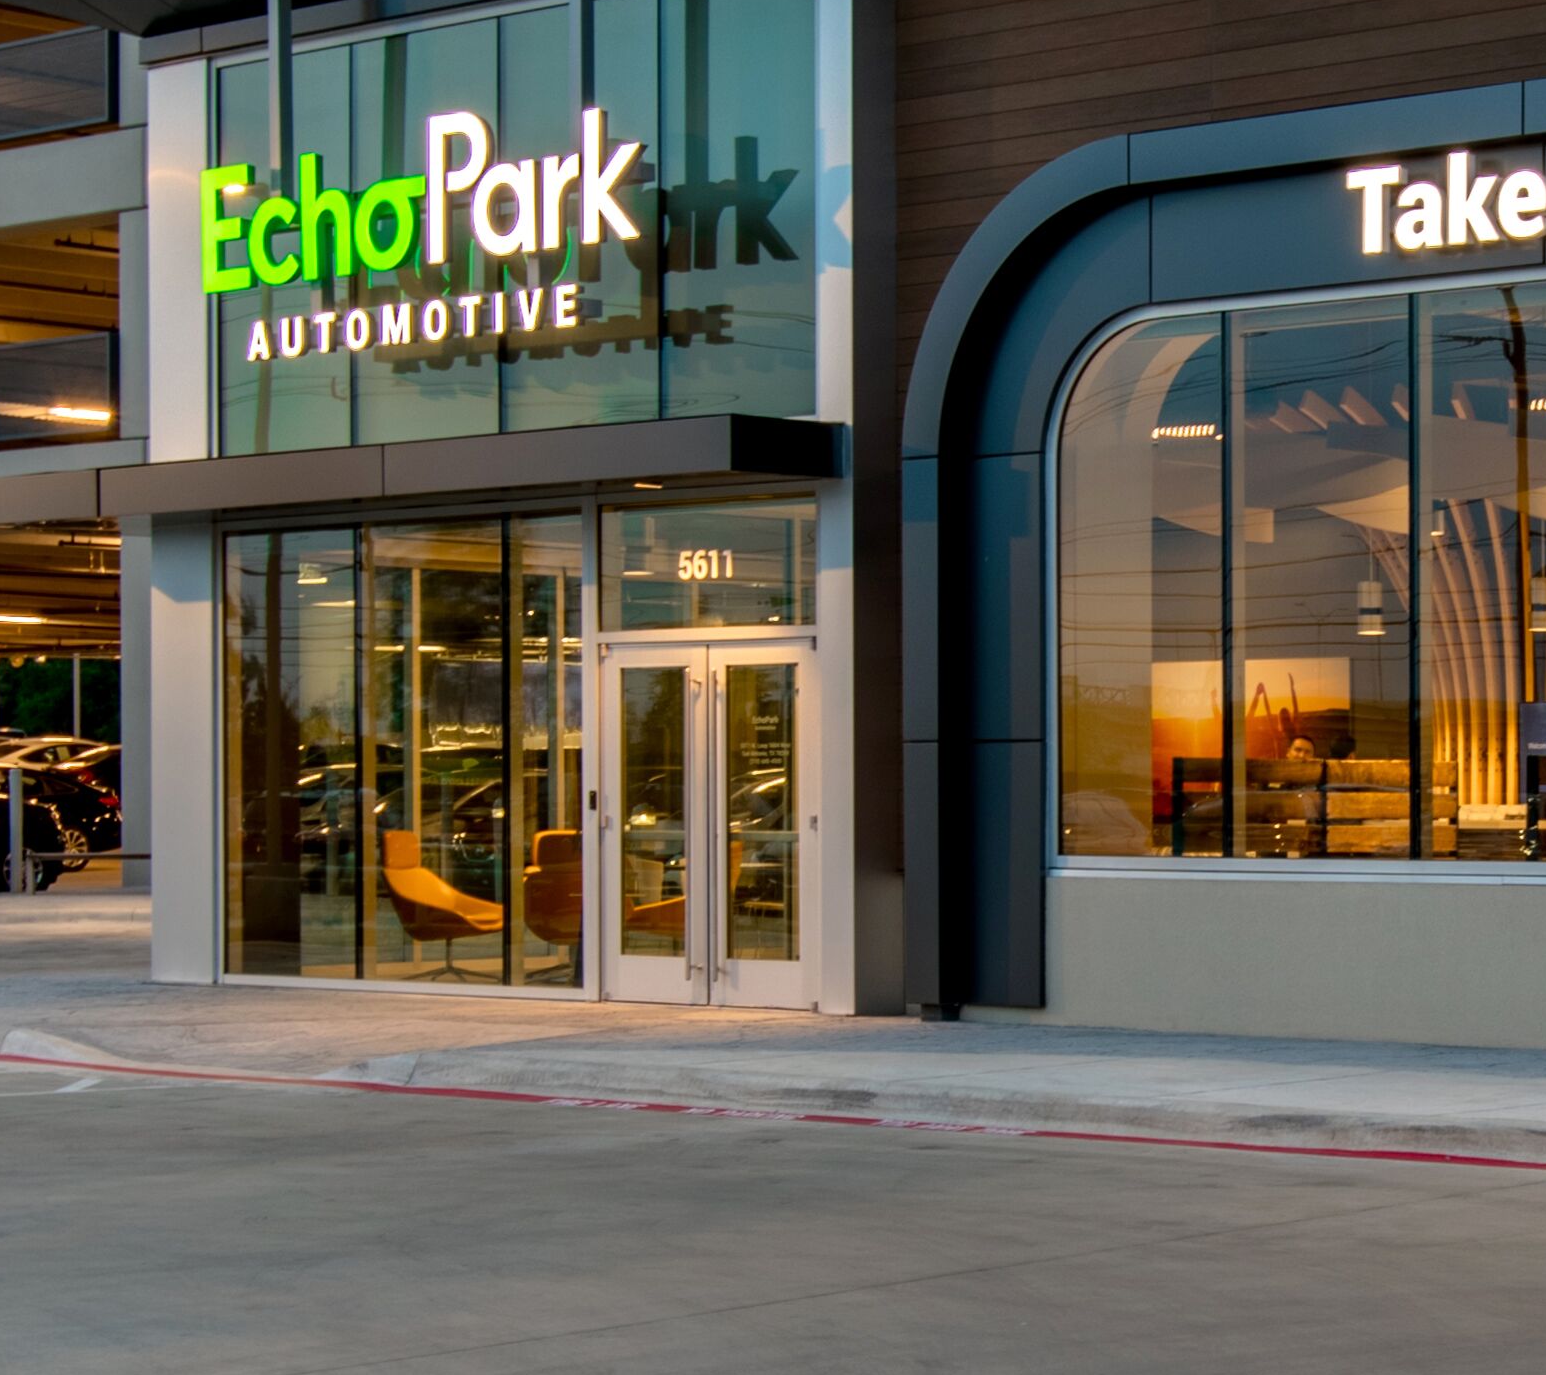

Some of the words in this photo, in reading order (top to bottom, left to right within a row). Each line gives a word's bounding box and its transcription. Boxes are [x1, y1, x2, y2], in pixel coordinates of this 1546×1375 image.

[200, 107, 646, 294] EchoPark
[247, 283, 582, 362] AUTOMOTIVE
[678, 549, 733, 581] 5611
